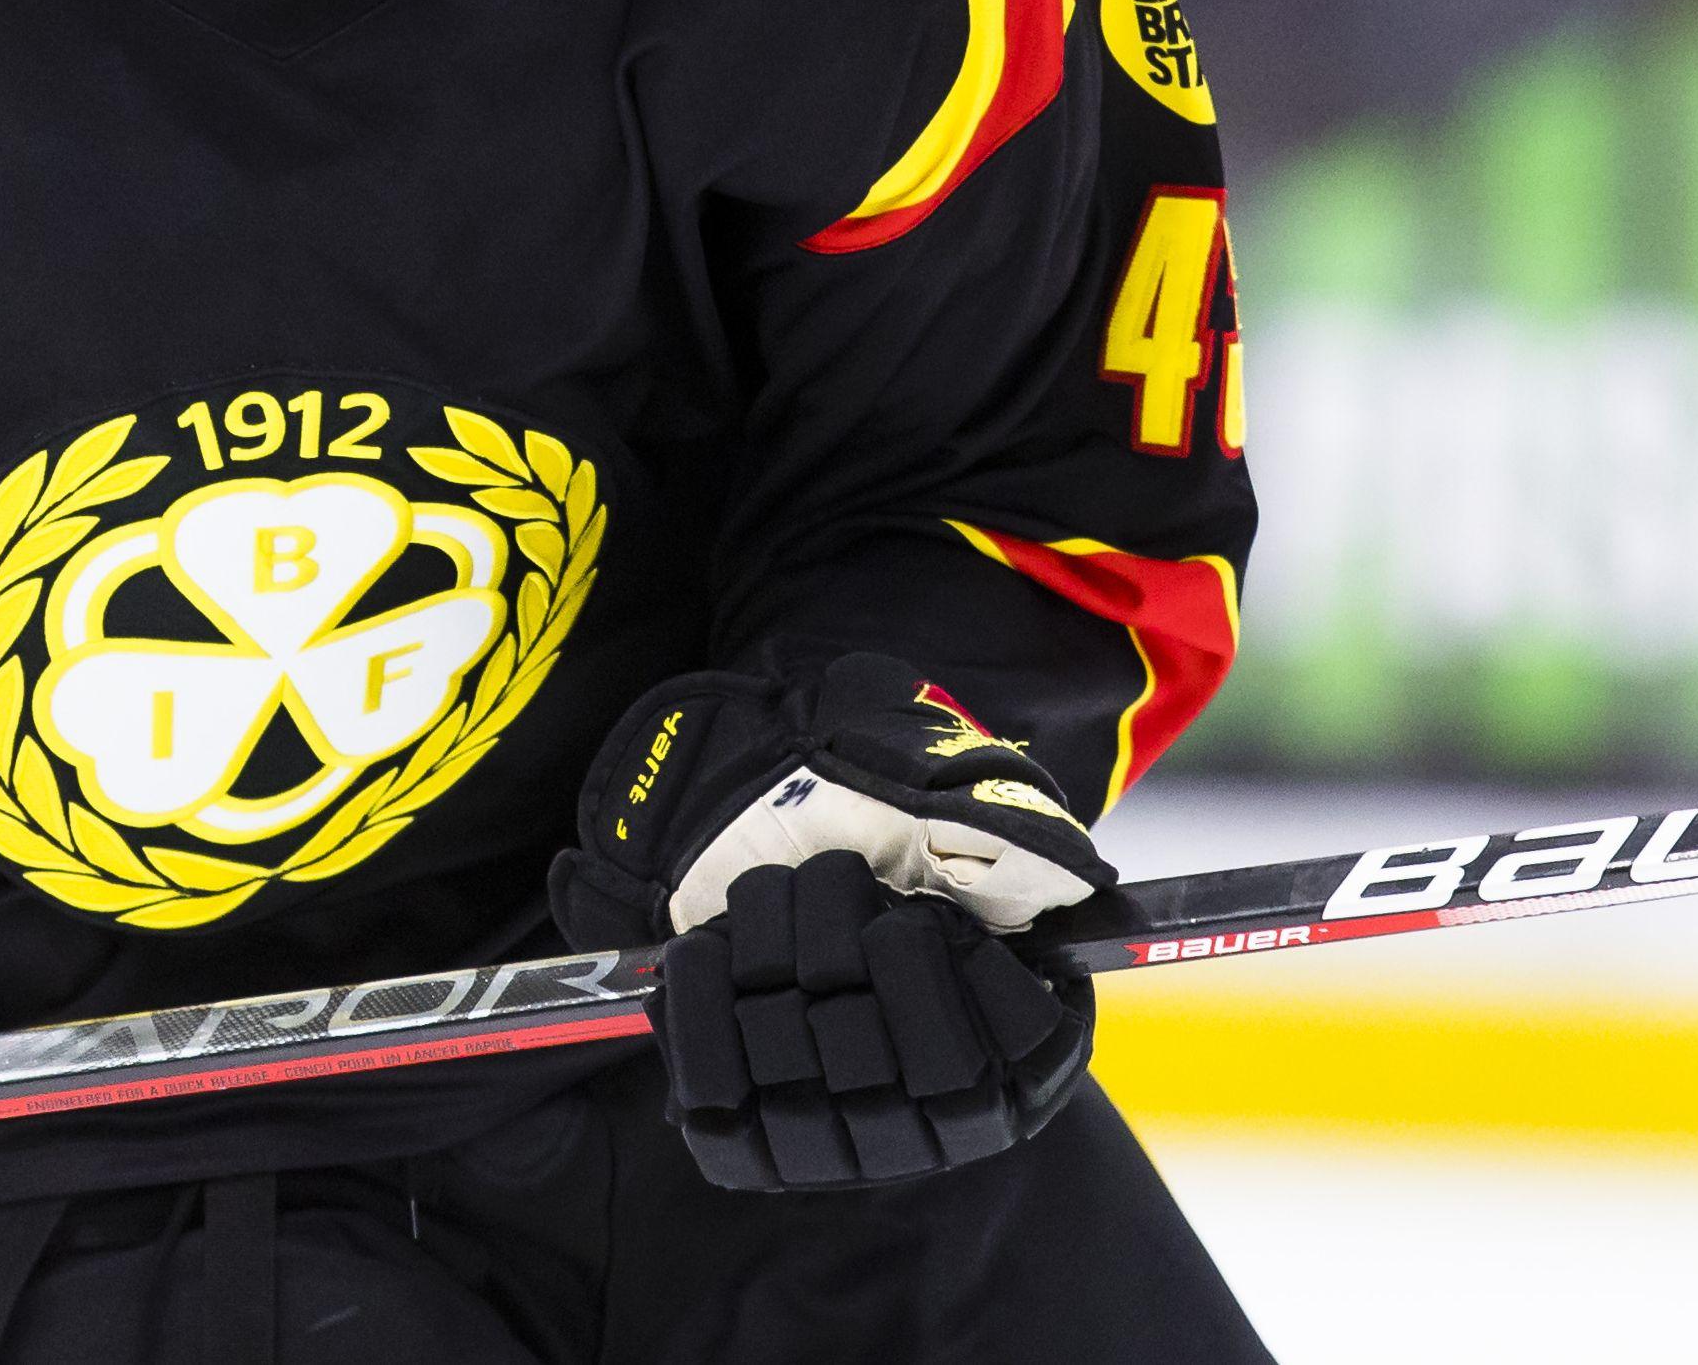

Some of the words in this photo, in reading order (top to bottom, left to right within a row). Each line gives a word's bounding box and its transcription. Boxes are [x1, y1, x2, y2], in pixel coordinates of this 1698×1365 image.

[1101, 184, 1246, 459] 4
[177, 390, 391, 471] 1912
[254, 525, 320, 595] B
[151, 691, 175, 760] I
[362, 642, 425, 715] F
[1147, 925, 1311, 963] BAUER
[116, 1088, 144, 1100] FOR
[149, 1086, 159, 1097] A
